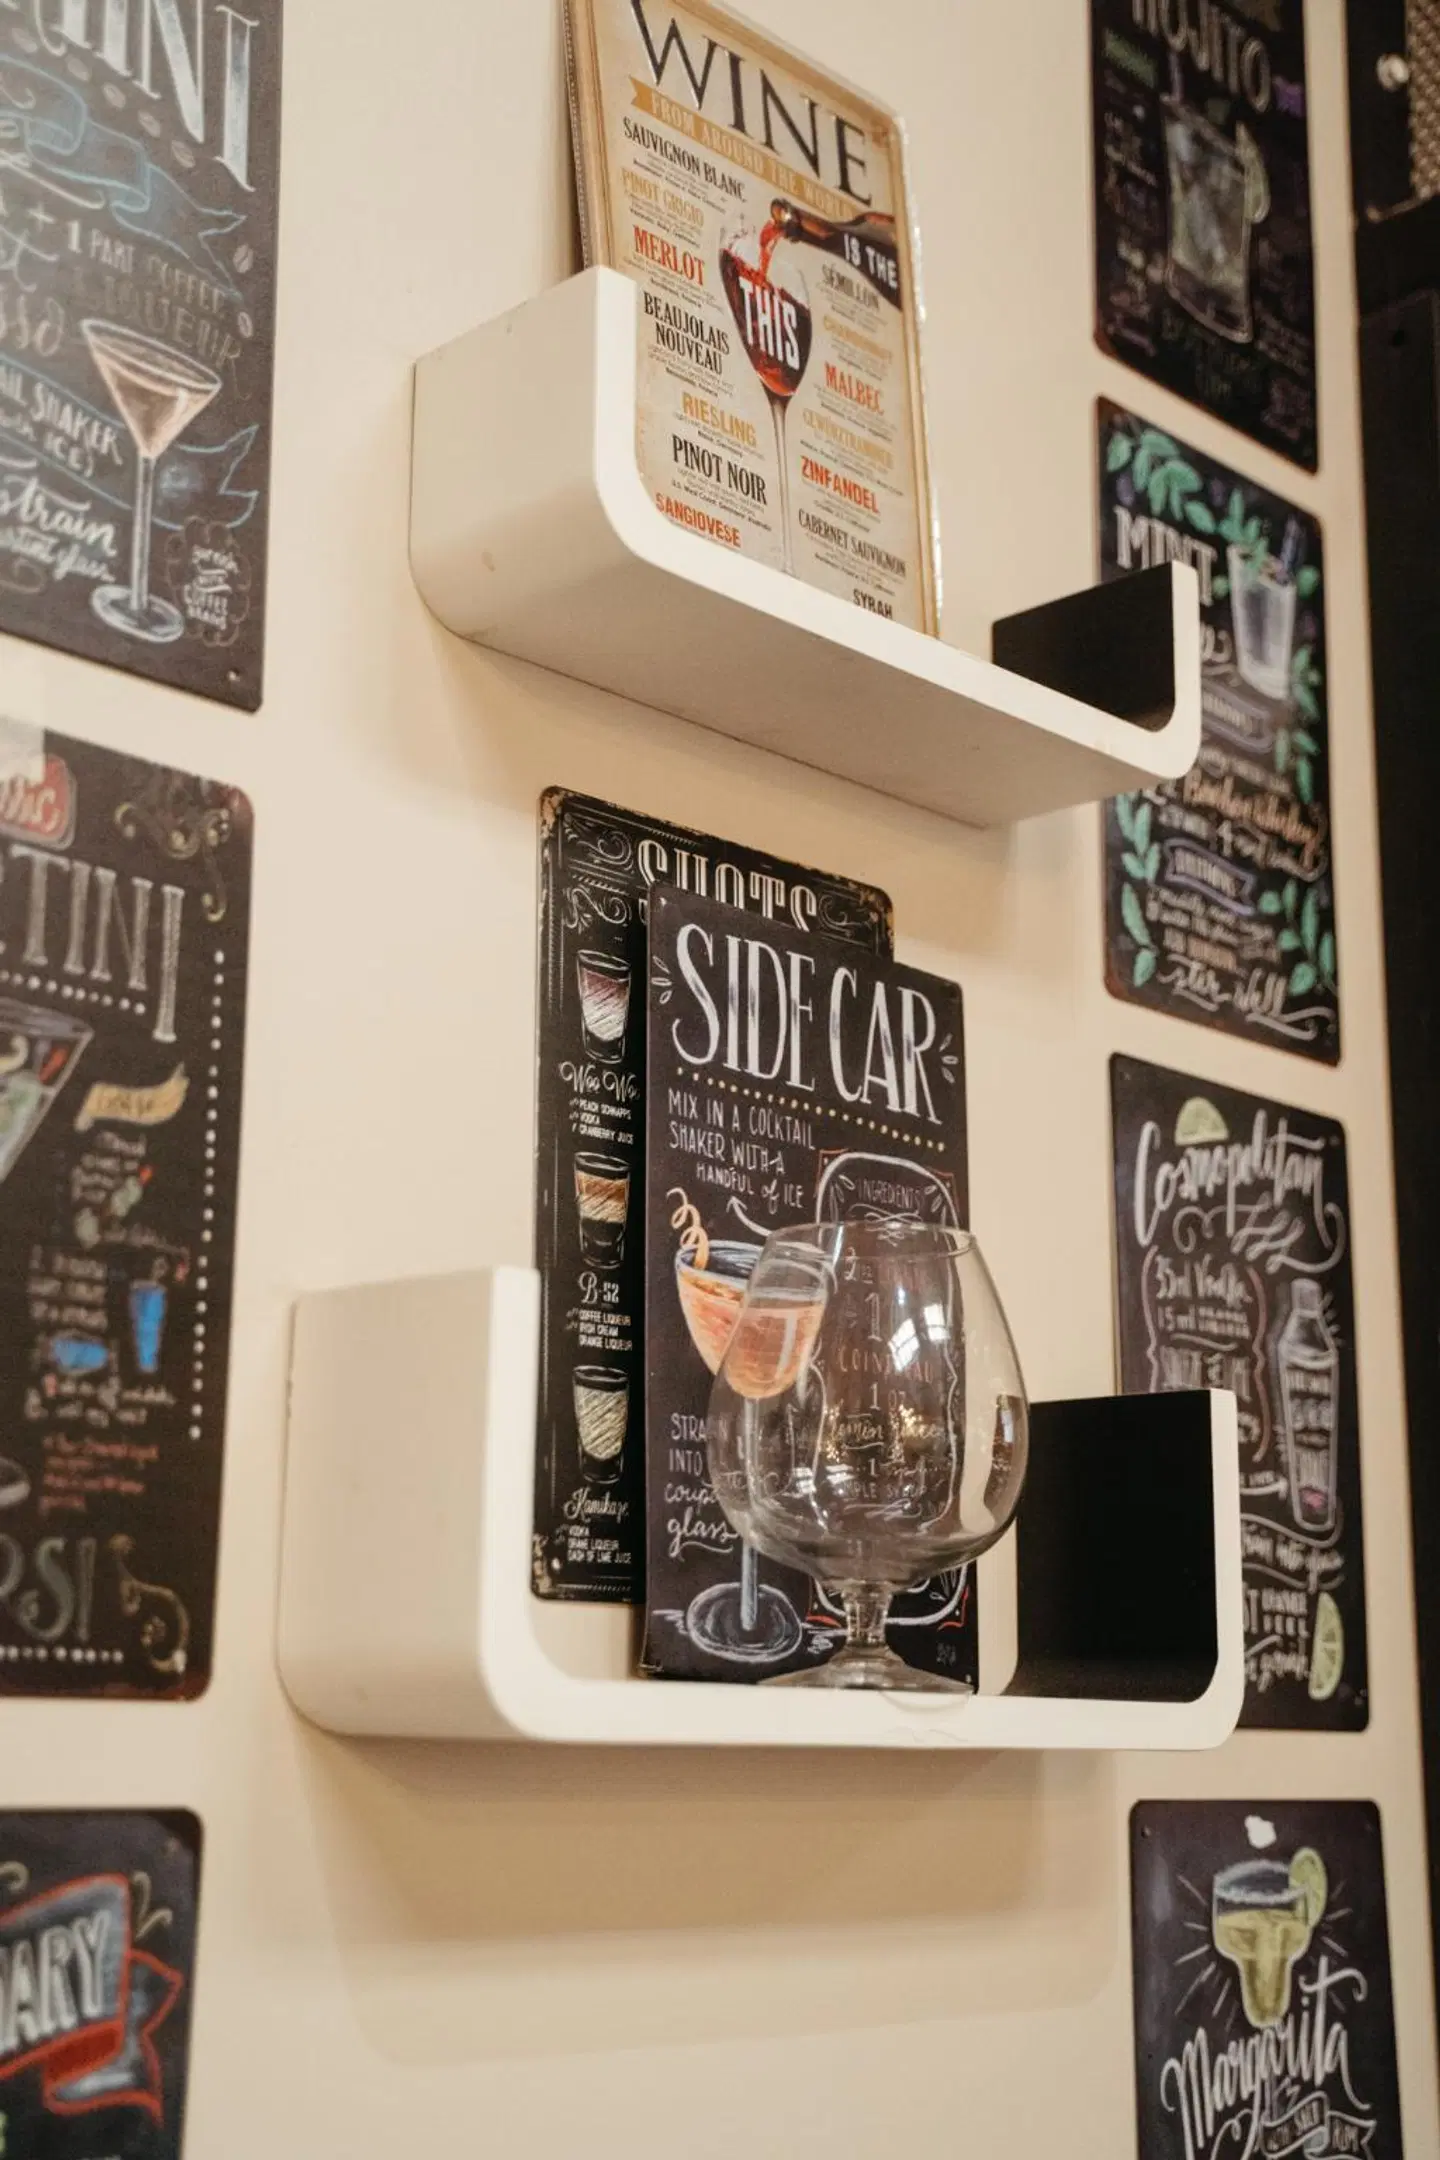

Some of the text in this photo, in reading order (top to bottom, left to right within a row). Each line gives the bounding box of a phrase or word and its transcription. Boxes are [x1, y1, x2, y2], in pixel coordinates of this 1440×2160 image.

[631, 0, 873, 208] WINE
[622, 115, 701, 177] SAUVIGNON
[702, 161, 748, 203] BLANC
[632, 224, 705, 287] MERLOT
[843, 232, 898, 292] IS THE
[643, 290, 730, 355] BEAUJOLAIS
[655, 321, 723, 376] NOUVEAU
[738, 270, 801, 372] THIS
[824, 359, 885, 417] MALBEC
[29, 381, 124, 466] SHAKER
[681, 391, 758, 448] RIESLING
[671, 432, 723, 483] PINOT
[726, 460, 768, 506] NOIR
[801, 454, 881, 516] ZINFANDEL
[655, 491, 743, 548] SANGIOVESE
[797, 507, 849, 551] CABERNET
[850, 536, 907, 579] SAUVIGNON
[852, 587, 894, 621] SYRAH
[558, 1061, 601, 1095] Woo
[667, 1087, 816, 1151] MIX IN A COCKTAIL
[668, 1120, 786, 1176] SHAKER WITH A
[696, 1161, 804, 1214] HANDFUL of ICE
[670, 1411, 729, 1443] STRAN
[669, 1447, 704, 1478] INTO
[667, 1507, 742, 1558] glass
[0, 1907, 113, 2053] ARY
